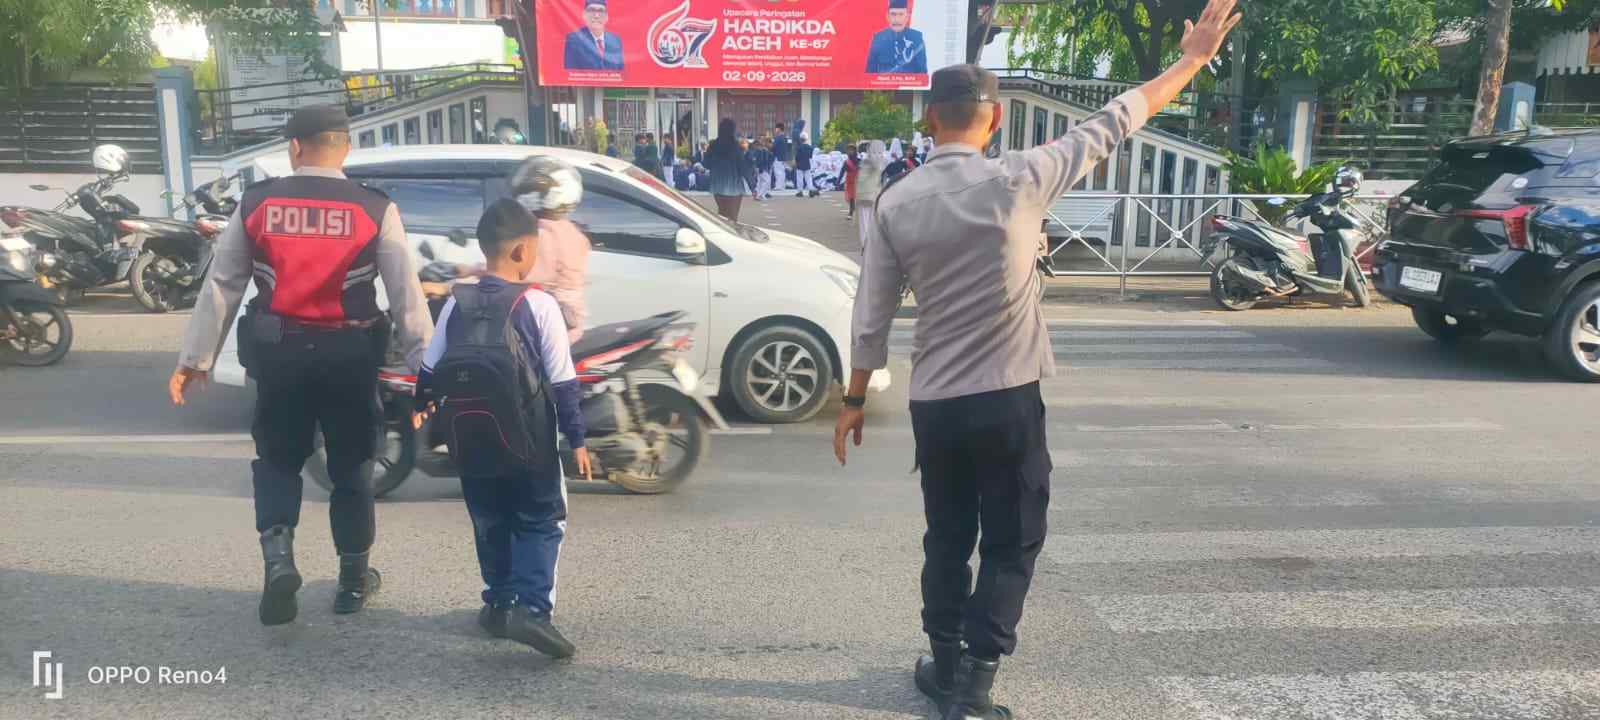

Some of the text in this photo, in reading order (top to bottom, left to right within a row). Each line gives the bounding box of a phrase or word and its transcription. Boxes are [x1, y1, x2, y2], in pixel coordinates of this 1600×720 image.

[723, 18, 837, 35] HARDIKDA
[721, 35, 831, 51] ACEH KE-67
[265, 205, 352, 236] POLISI
